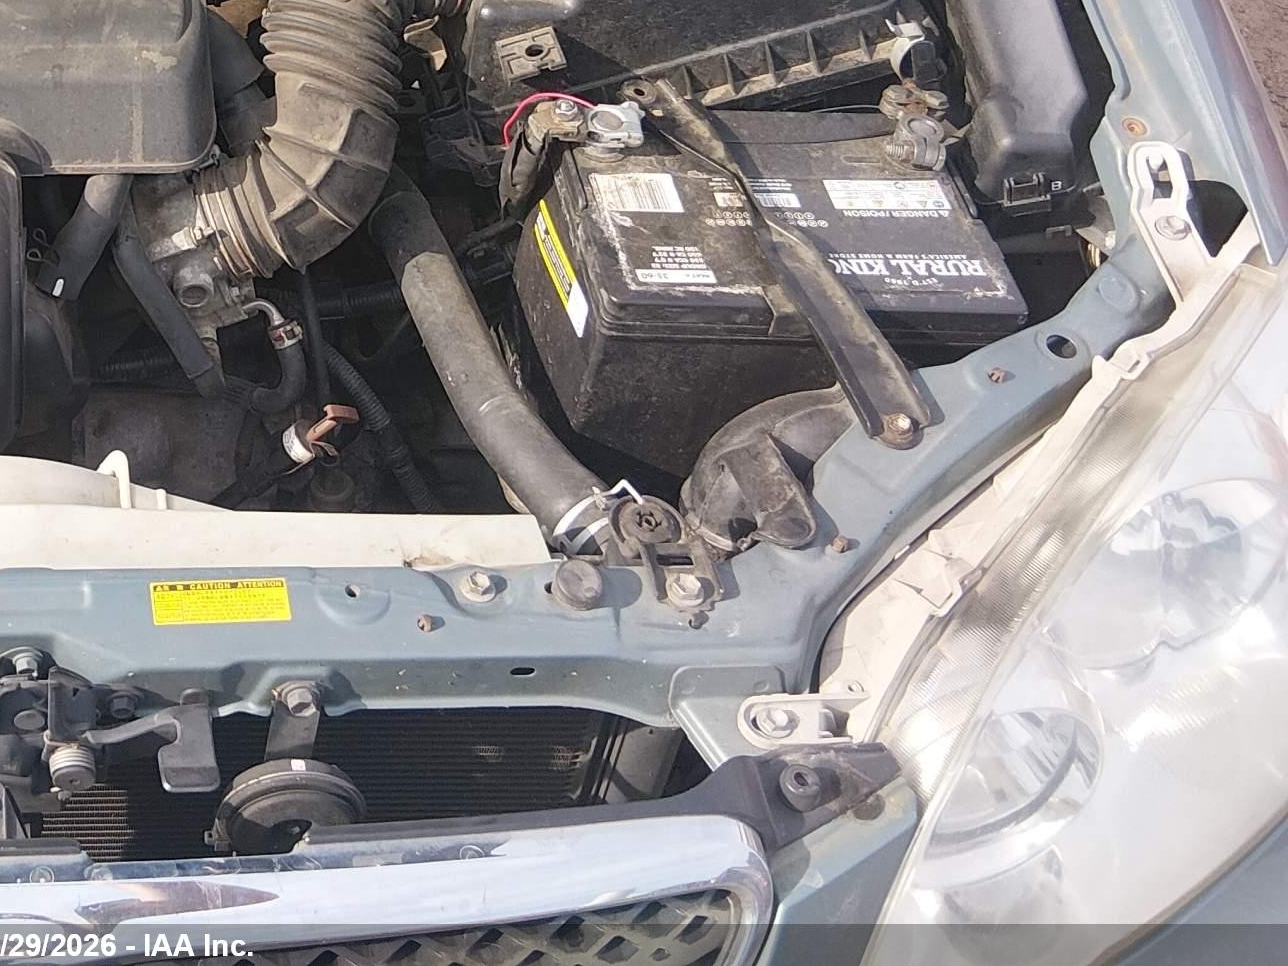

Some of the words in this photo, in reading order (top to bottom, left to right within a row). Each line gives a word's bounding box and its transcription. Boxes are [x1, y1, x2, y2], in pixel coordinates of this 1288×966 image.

[892, 210, 939, 218] DANGER
[889, 259, 987, 276] RURAL
[189, 582, 232, 591] CAUTION
[236, 580, 282, 589] ATTENTION
